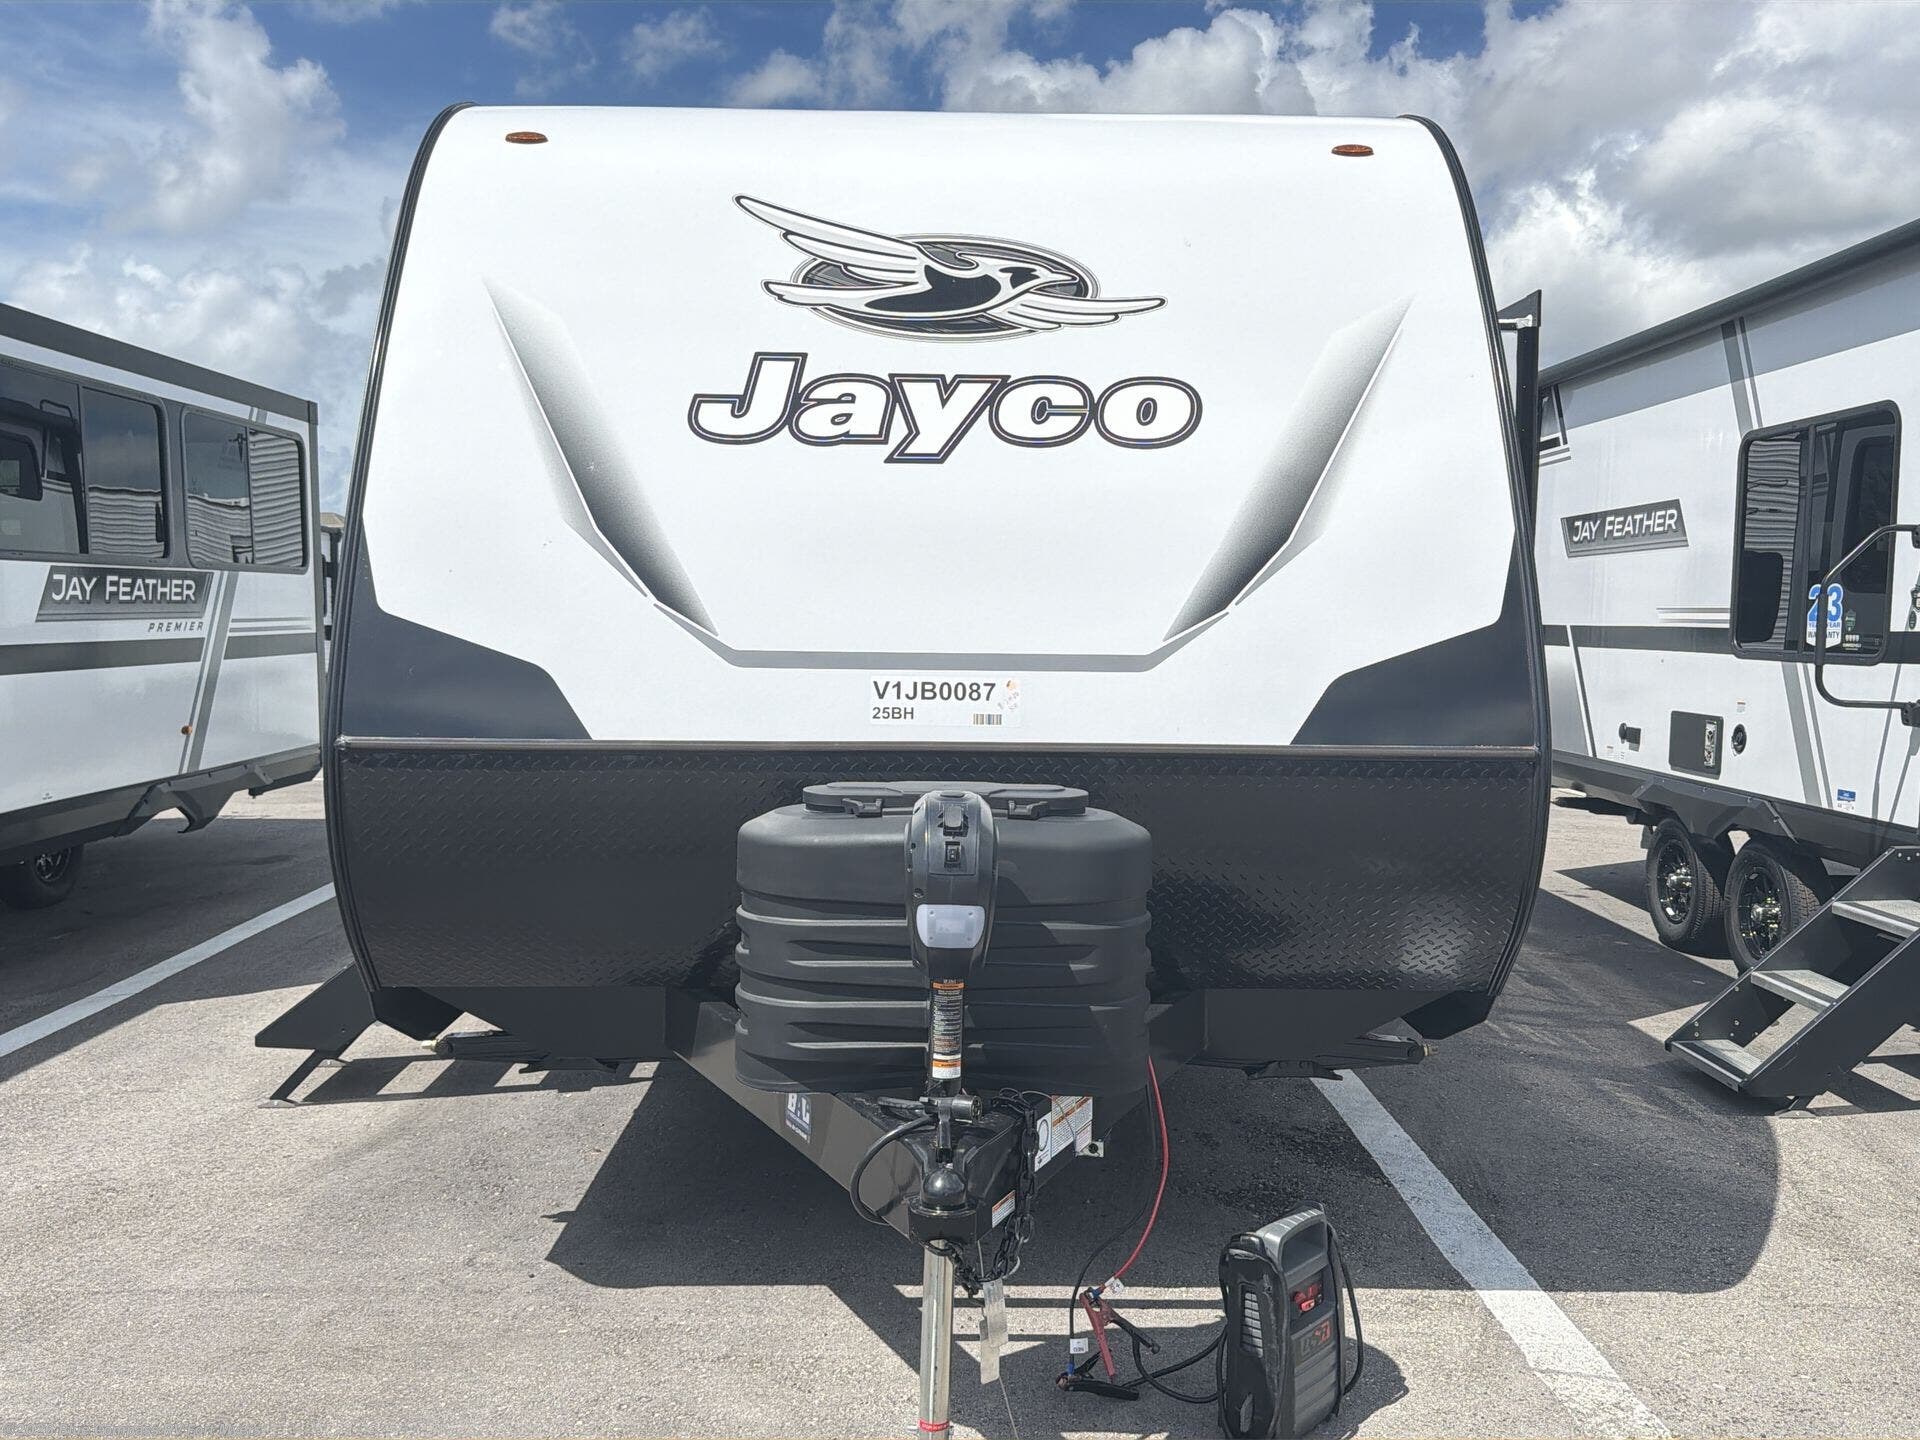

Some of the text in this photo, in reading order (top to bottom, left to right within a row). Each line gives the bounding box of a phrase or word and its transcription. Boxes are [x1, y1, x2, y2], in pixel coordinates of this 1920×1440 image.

[687, 352, 1203, 464] Jayco
[1572, 509, 1678, 542] JAY FEATHER
[51, 574, 196, 601] JAY FEATHER
[148, 621, 204, 633] PREMIER
[873, 681, 996, 702] V1JB0087
[872, 706, 915, 720] 25BH
